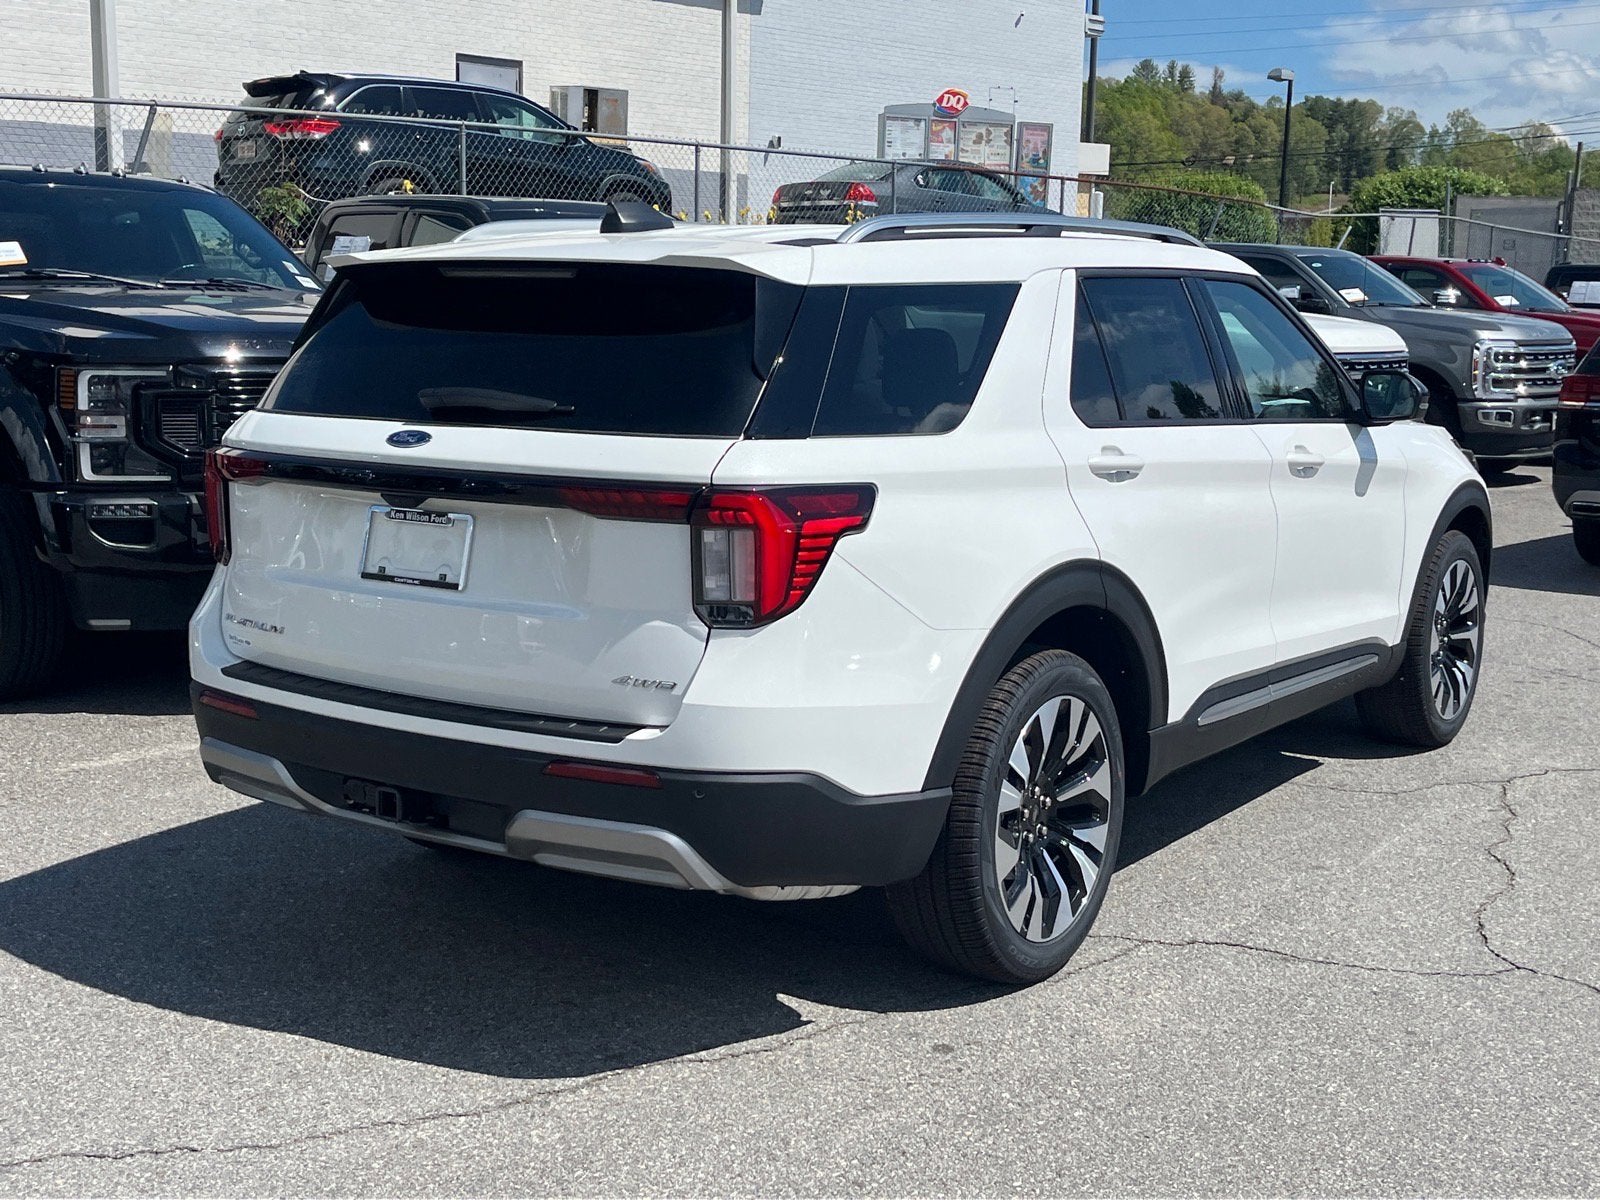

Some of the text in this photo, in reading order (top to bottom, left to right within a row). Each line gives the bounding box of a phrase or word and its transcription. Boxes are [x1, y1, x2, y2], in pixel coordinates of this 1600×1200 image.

[941, 93, 965, 110] DQ
[390, 510, 448, 524] Ken Wilson Ford
[611, 675, 677, 690] 4WD
